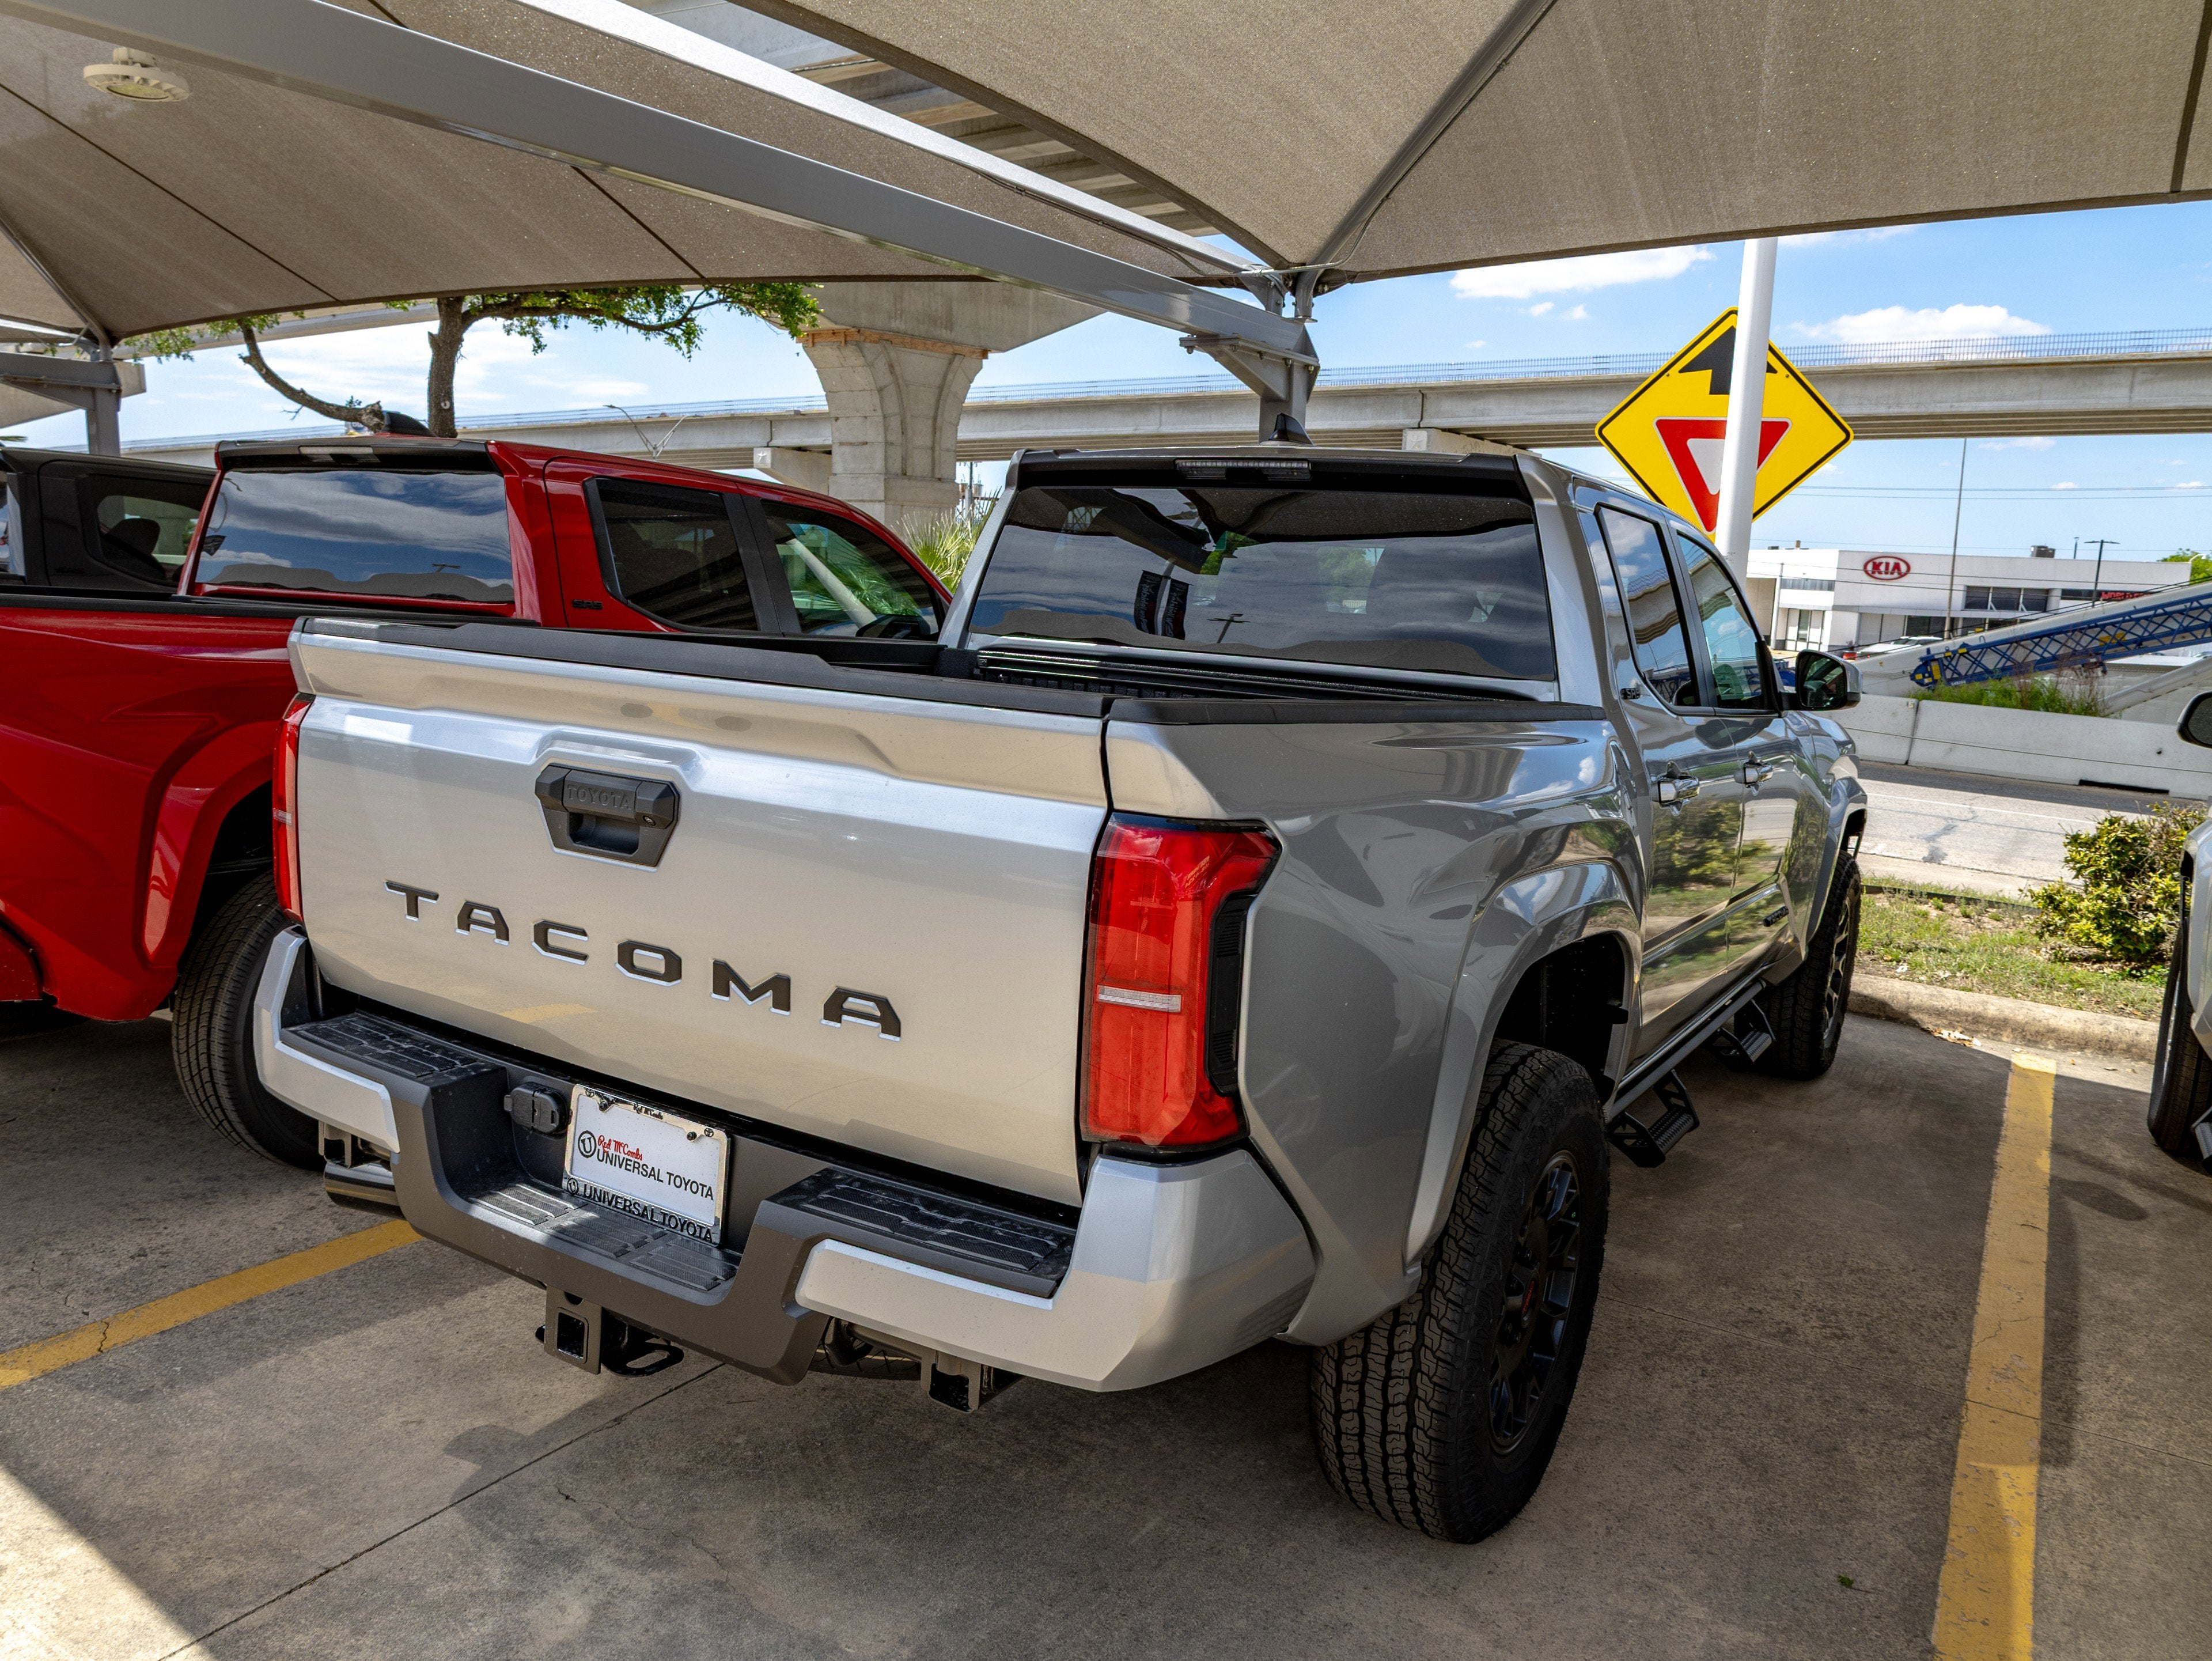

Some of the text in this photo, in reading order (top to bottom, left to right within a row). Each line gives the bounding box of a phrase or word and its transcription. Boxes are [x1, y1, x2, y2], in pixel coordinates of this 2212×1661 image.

[1872, 561, 1902, 576] KIA
[567, 784, 632, 810] TOYOTA
[385, 880, 902, 1039] TACOMA
[598, 1134, 643, 1161] Red McCombs
[597, 1152, 714, 1201] UNIVERSAL TOYOTA
[584, 1185, 713, 1243] UNIVERSAL TOYOTA
